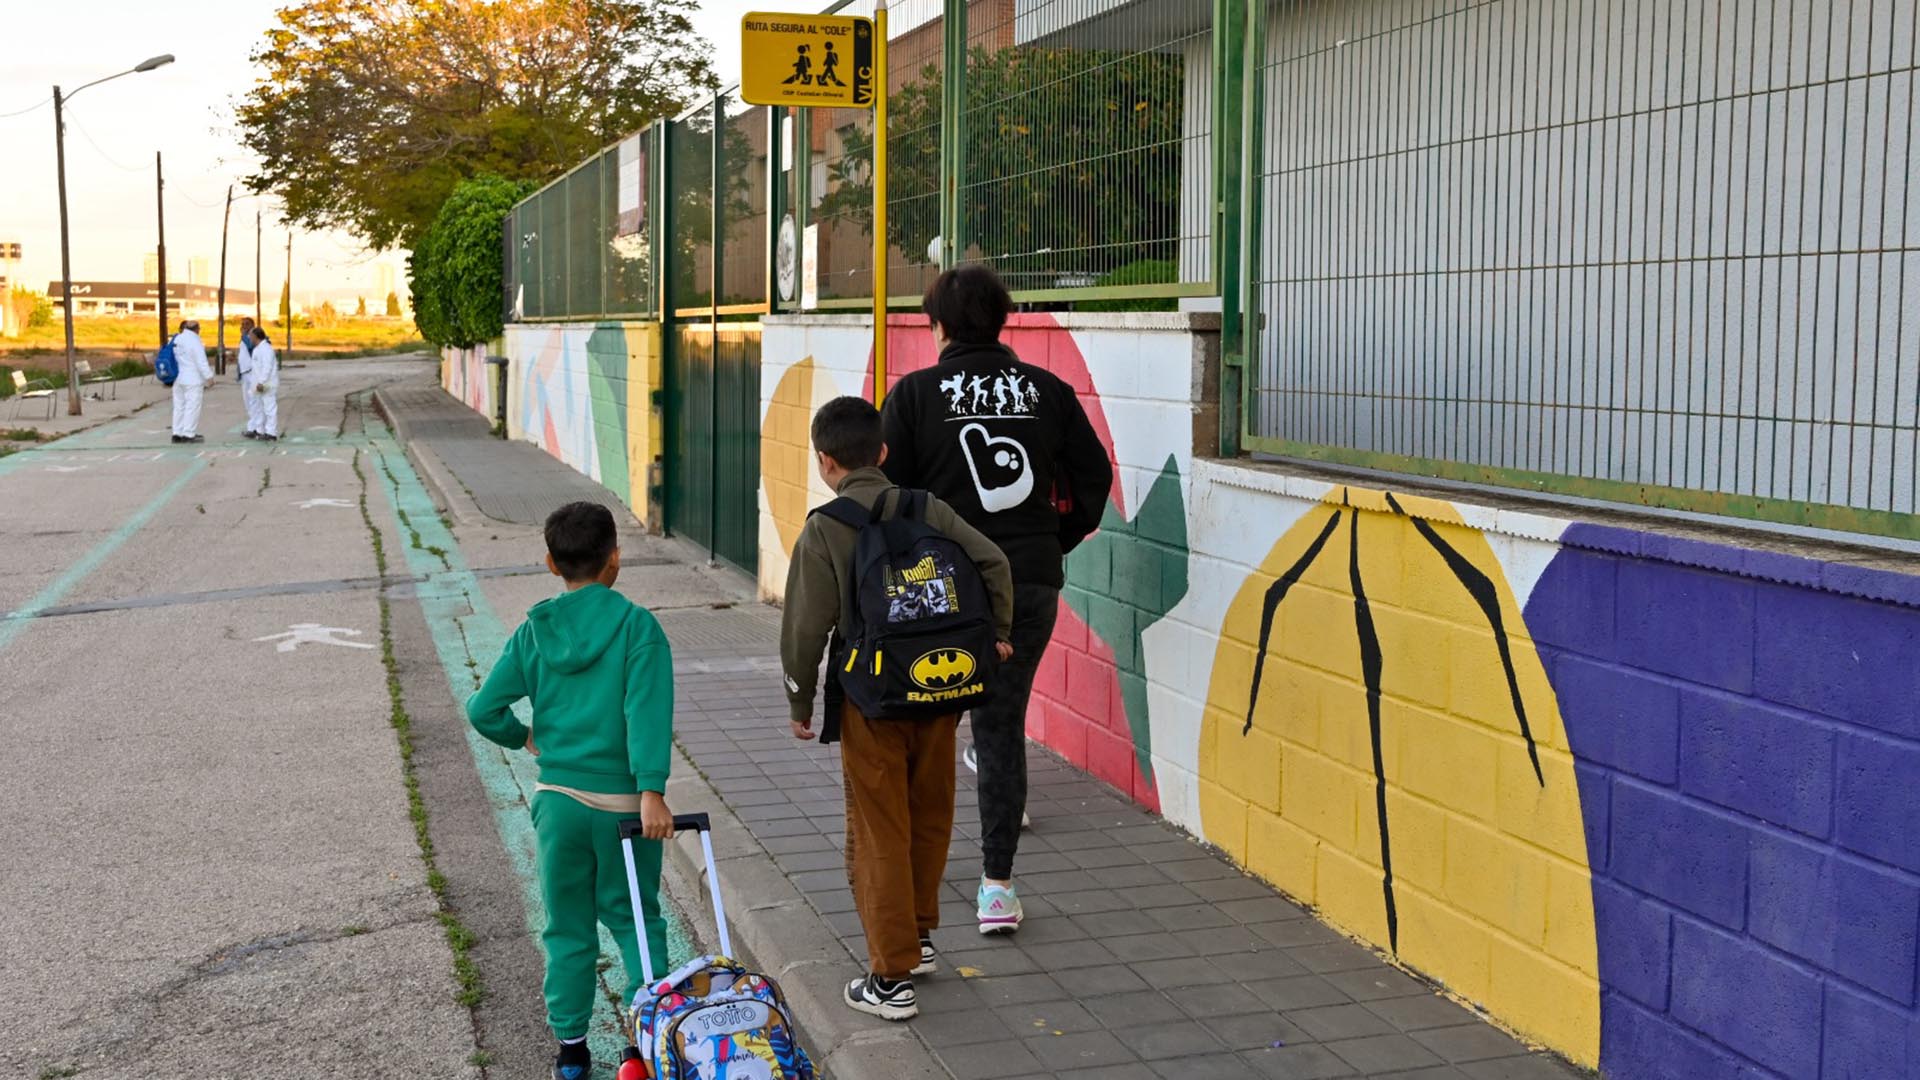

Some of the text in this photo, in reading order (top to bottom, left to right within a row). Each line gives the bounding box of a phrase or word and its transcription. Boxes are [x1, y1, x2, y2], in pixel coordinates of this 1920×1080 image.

[745, 21, 769, 32] RUTA
[770, 22, 805, 34] SEGURA
[807, 24, 819, 35] AL
[858, 66, 873, 102] VLC
[901, 556, 937, 583] KNIGHT
[906, 682, 984, 703] BATMAN
